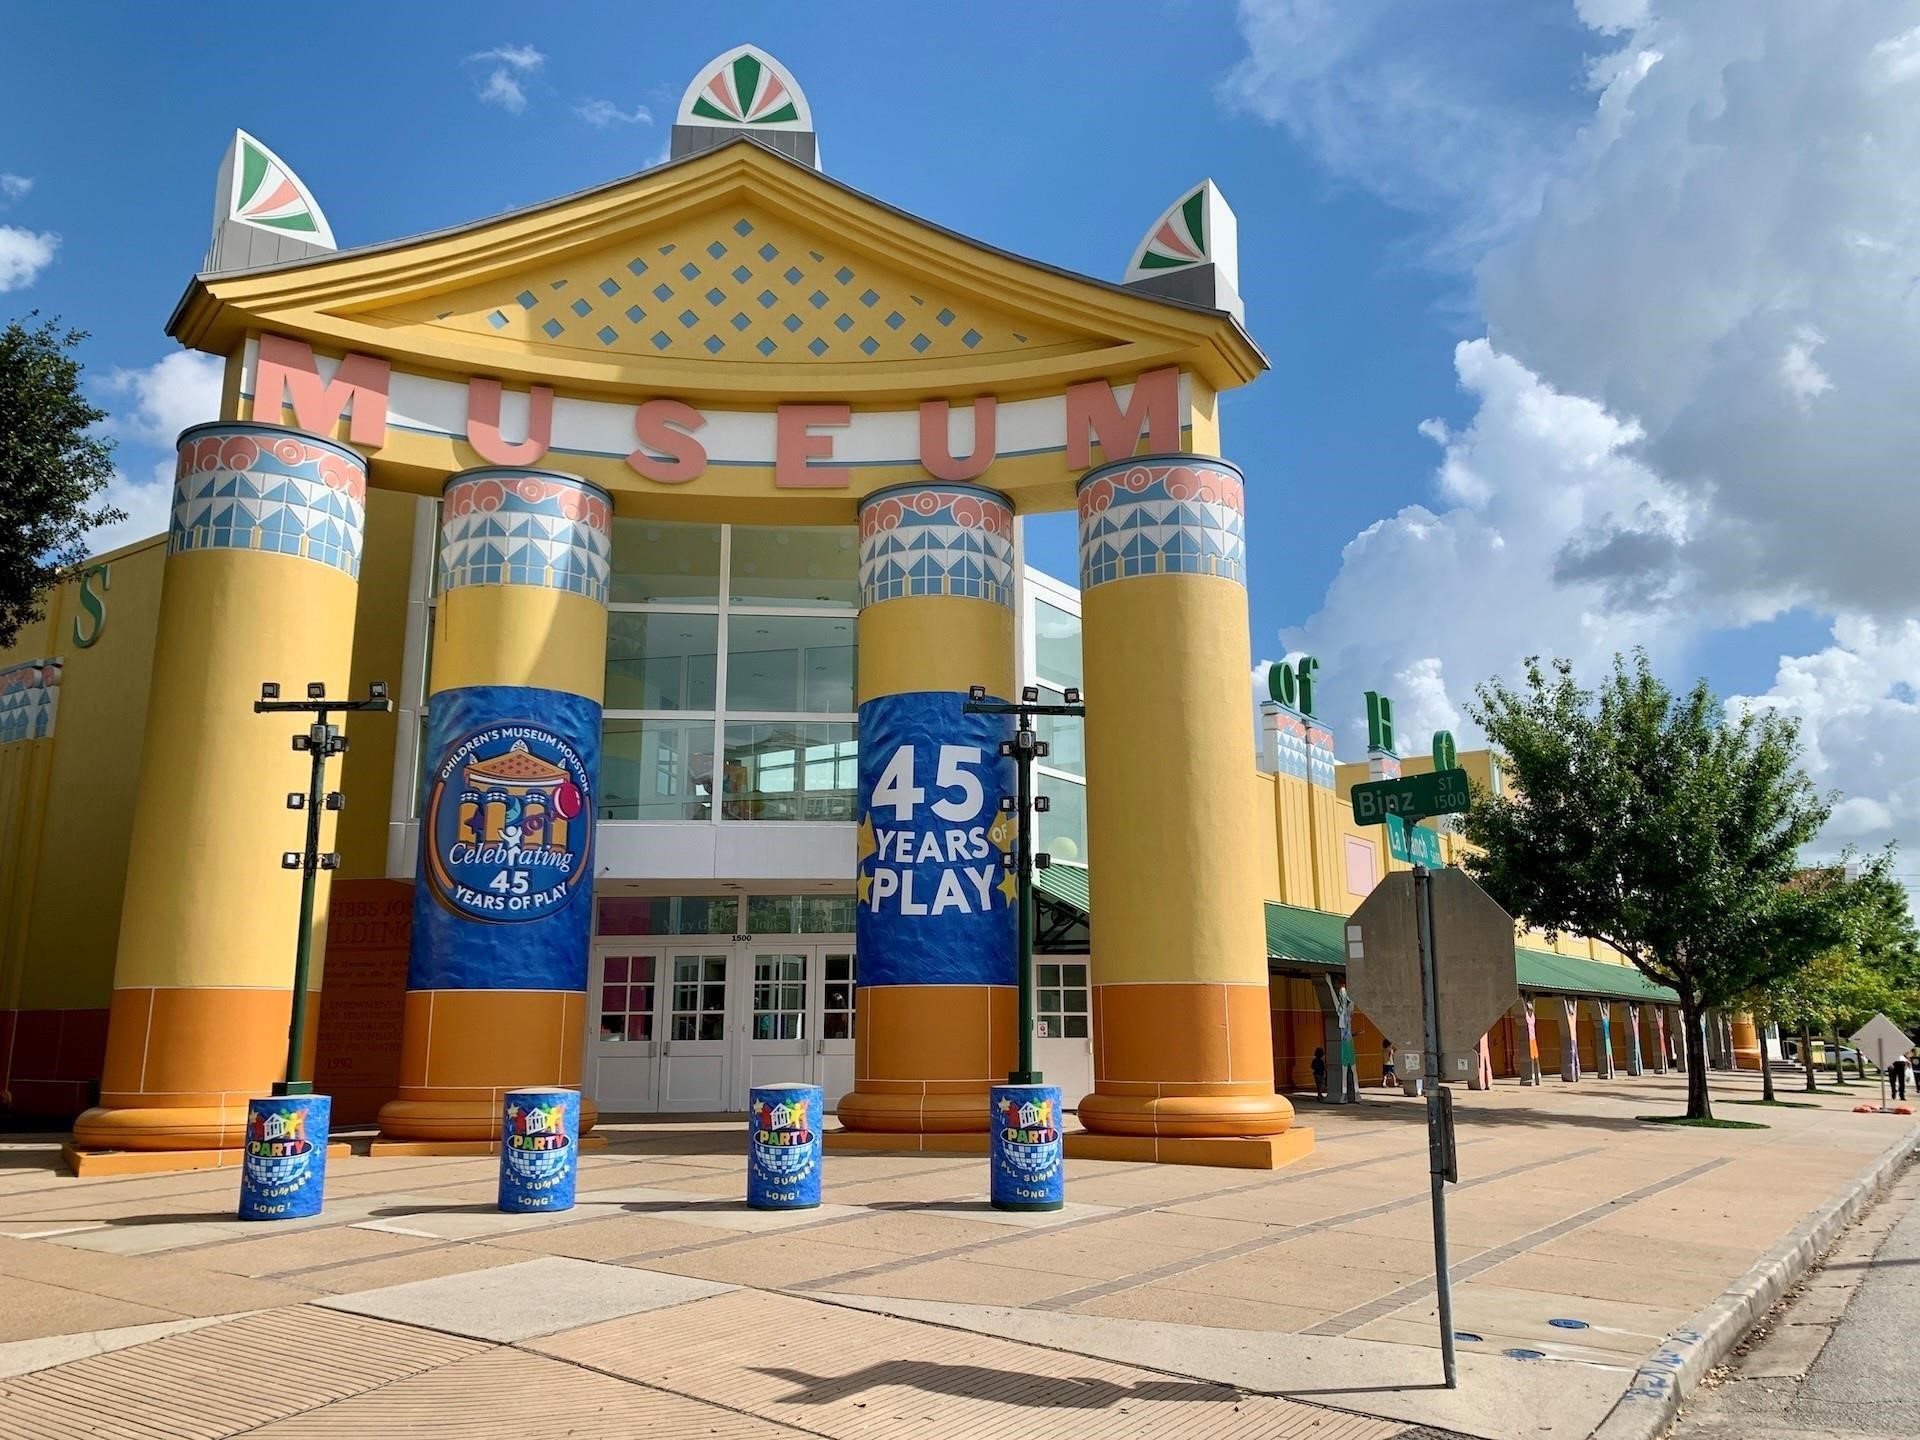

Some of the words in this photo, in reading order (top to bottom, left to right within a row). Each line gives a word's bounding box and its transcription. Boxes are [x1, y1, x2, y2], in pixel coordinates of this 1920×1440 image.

[253, 334, 1182, 488] MUSEUM
[441, 729, 500, 780] CHILDREN'S
[502, 727, 557, 748] MUSEUM
[556, 740, 590, 793] HOUSTON
[871, 744, 984, 823] 45
[1438, 776, 1453, 791] ST
[1358, 790, 1416, 817] Binz
[1434, 791, 1466, 809] 1500
[876, 826, 990, 864] YEARS
[991, 825, 1008, 843] OF
[449, 842, 574, 873] Celebrating
[489, 869, 529, 894] 45
[871, 863, 996, 916] PLAY
[454, 884, 505, 910] YEARS
[508, 896, 531, 911] OF
[534, 881, 569, 908] PLAY
[731, 934, 752, 942] 1500
[513, 1134, 565, 1151] PARTY
[760, 1129, 809, 1146] PARTY
[1007, 1127, 1054, 1144] PARTY
[252, 1139, 306, 1157] PARTY
[505, 1168, 521, 1186] ALL
[526, 1164, 571, 1190] SUMMER
[753, 1163, 768, 1180] ALL
[773, 1160, 815, 1186] SUMMER
[1001, 1160, 1018, 1178] ALL
[262, 1170, 312, 1198] SUMMER
[1016, 1187, 1049, 1199] LONG!
[518, 1195, 554, 1207] LONG!
[766, 1190, 800, 1202] LONG!
[253, 1201, 292, 1214] LONG!
